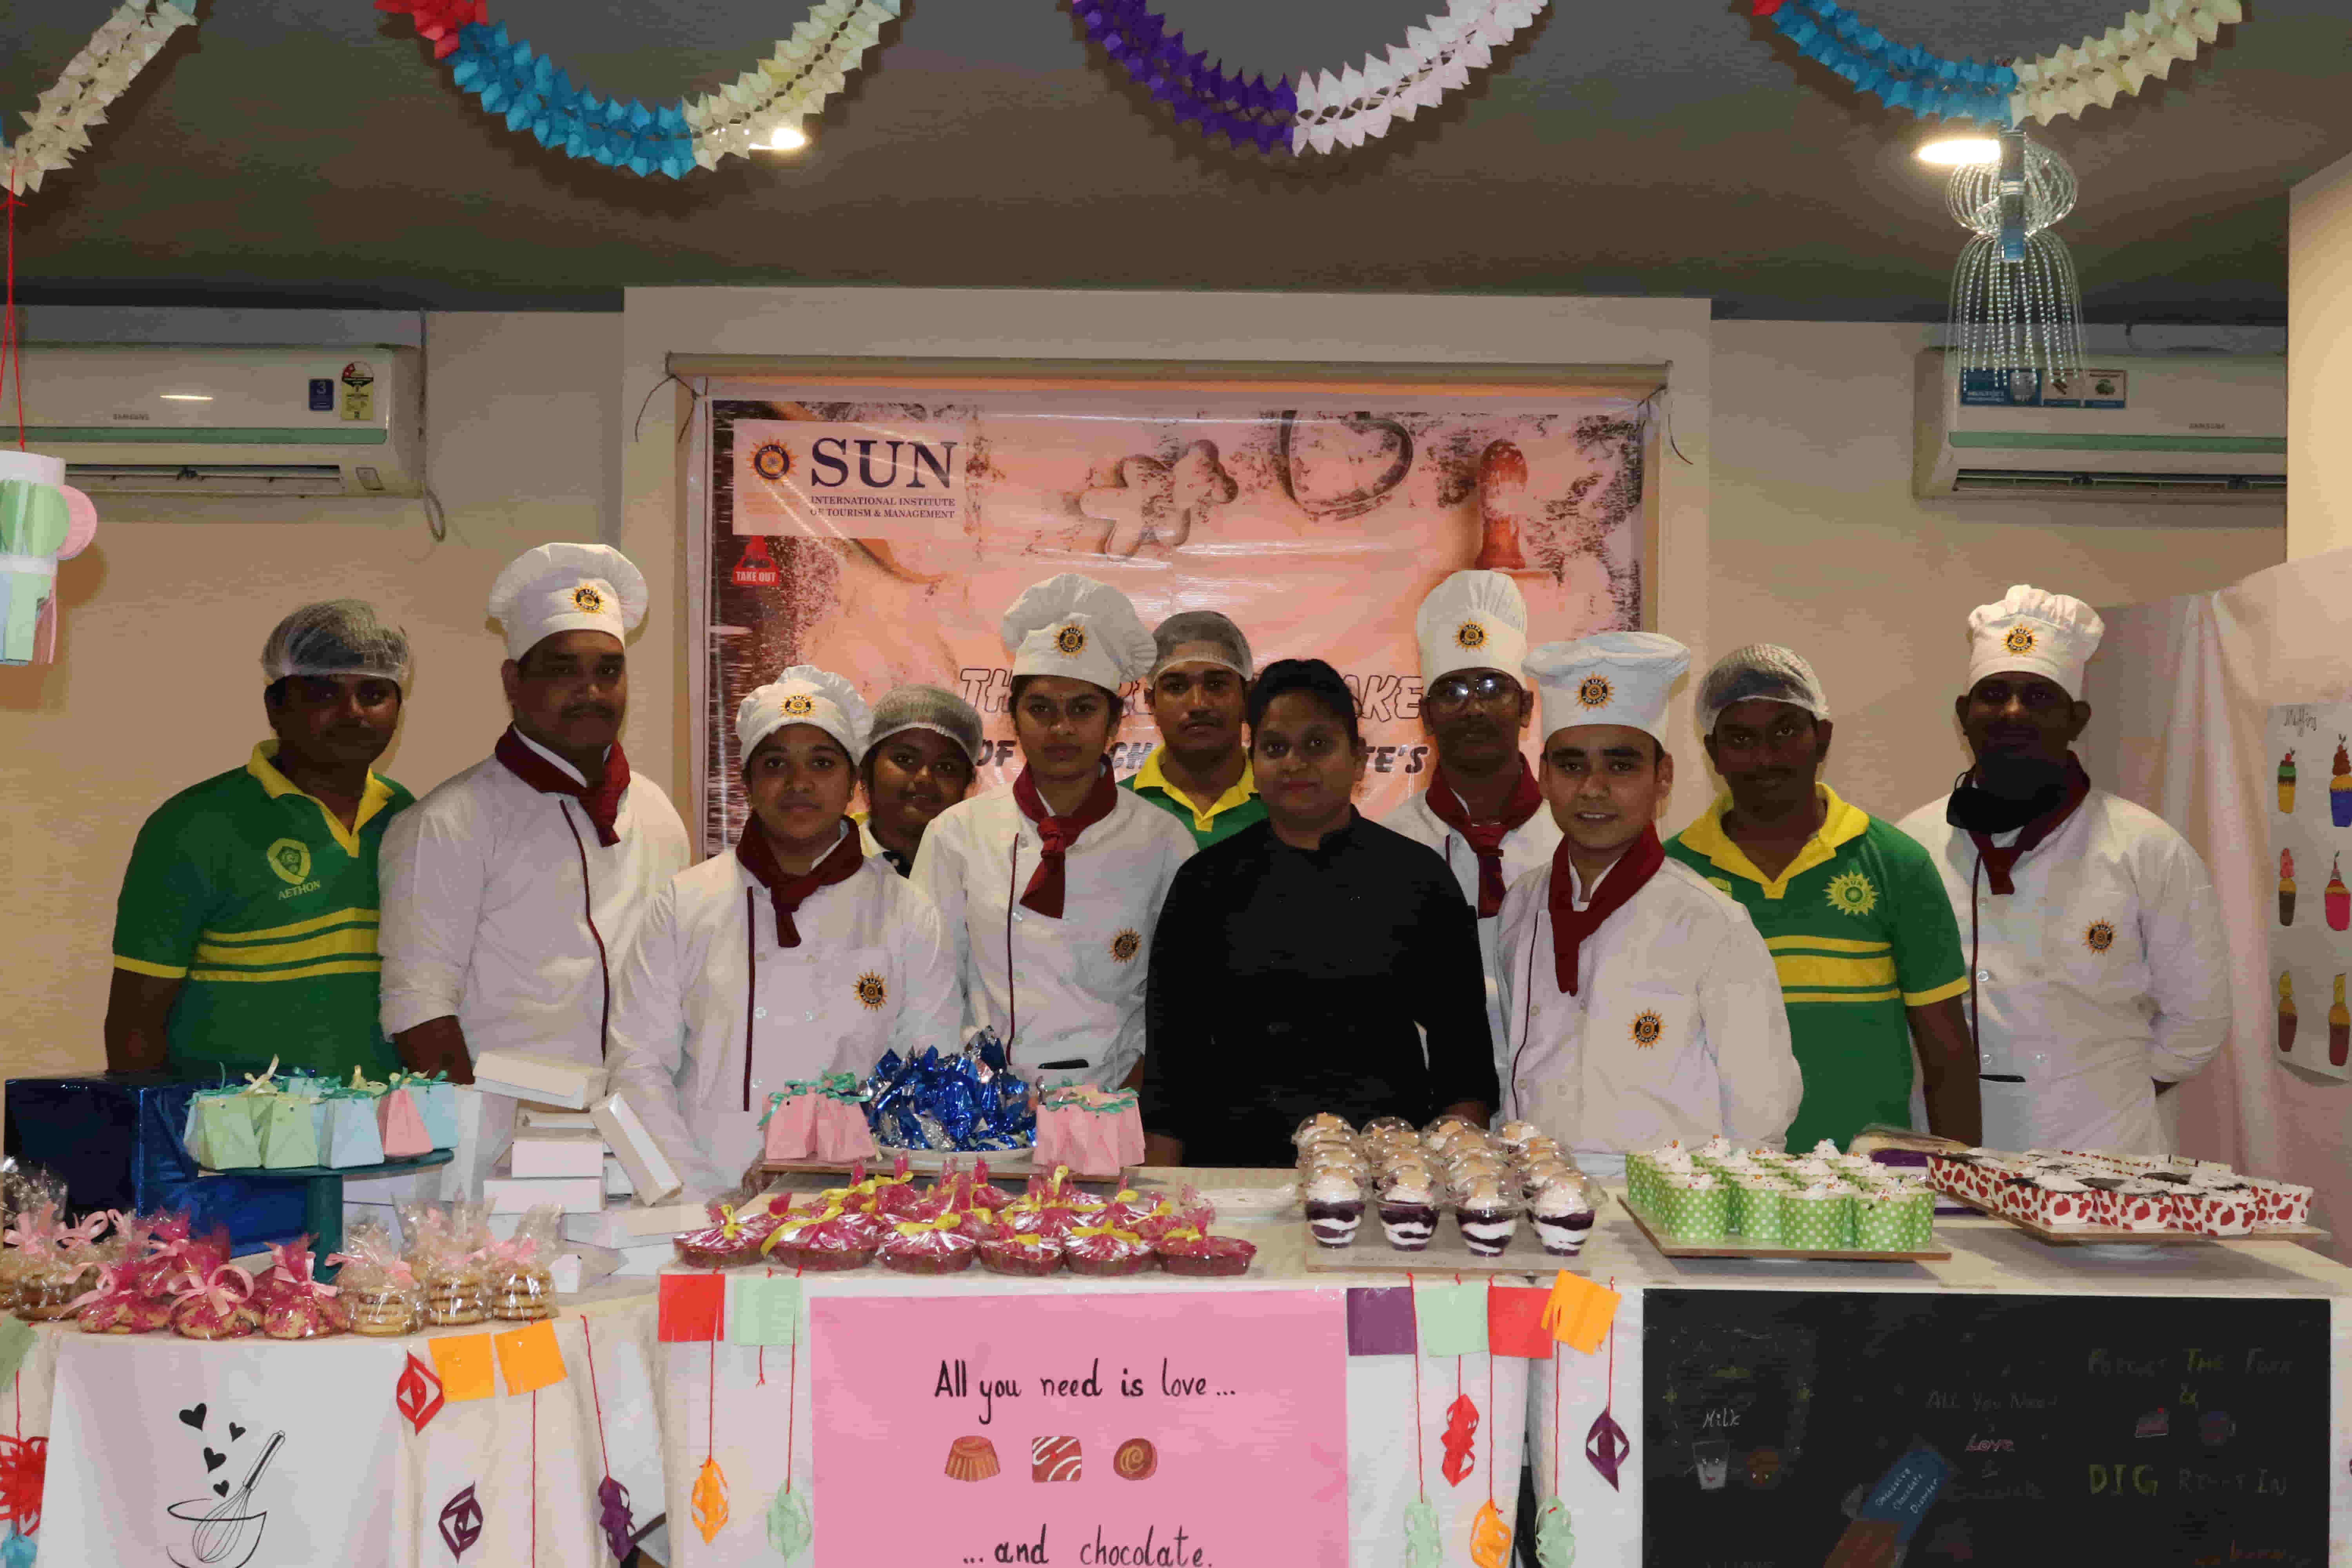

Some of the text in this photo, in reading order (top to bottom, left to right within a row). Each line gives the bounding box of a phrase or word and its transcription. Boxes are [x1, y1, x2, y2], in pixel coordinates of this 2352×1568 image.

[811, 437, 958, 488] SUN
[811, 495, 897, 506] INTERNATIONAL
[898, 497, 955, 506] INSTITUTE
[827, 509, 872, 518] TOURISM
[873, 509, 881, 517] &
[883, 509, 955, 518] MANAGEMENT
[735, 571, 777, 582] TAKE OUT
[277, 880, 320, 900] AETHON
[935, 1360, 967, 1397] All
[979, 1379, 1021, 1425] you
[1041, 1357, 1102, 1397] need
[1121, 1368, 1143, 1397] is
[1702, 1408, 1740, 1428] Milk
[2088, 1464, 2158, 1496] DIG
[1080, 1525, 1211, 1567] chocolate.
